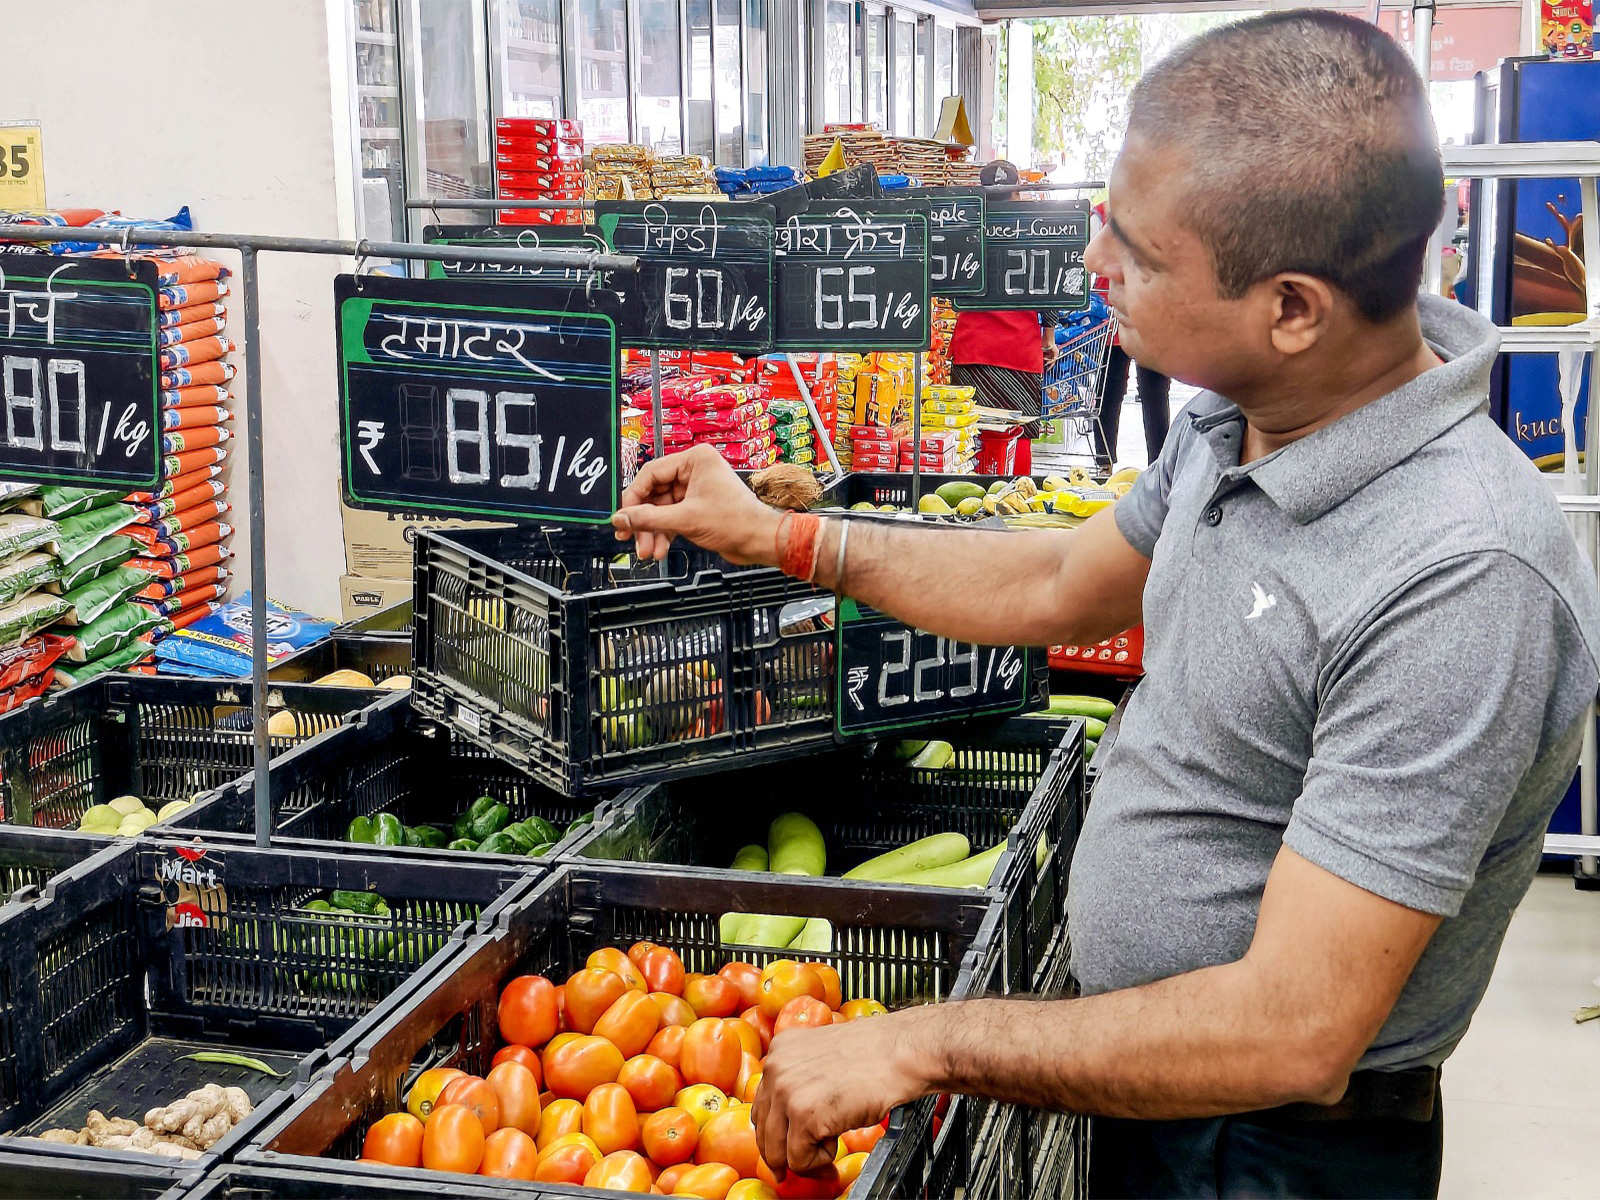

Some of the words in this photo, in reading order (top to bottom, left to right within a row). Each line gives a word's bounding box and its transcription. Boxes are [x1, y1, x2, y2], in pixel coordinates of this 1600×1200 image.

[380, 313, 566, 381] टमाटर
[1515, 411, 1564, 441] kuc
[208, 634, 237, 648] MEGA
[238, 642, 253, 655] PAC
[162, 858, 217, 889] Mart
[173, 912, 203, 928] Jio
